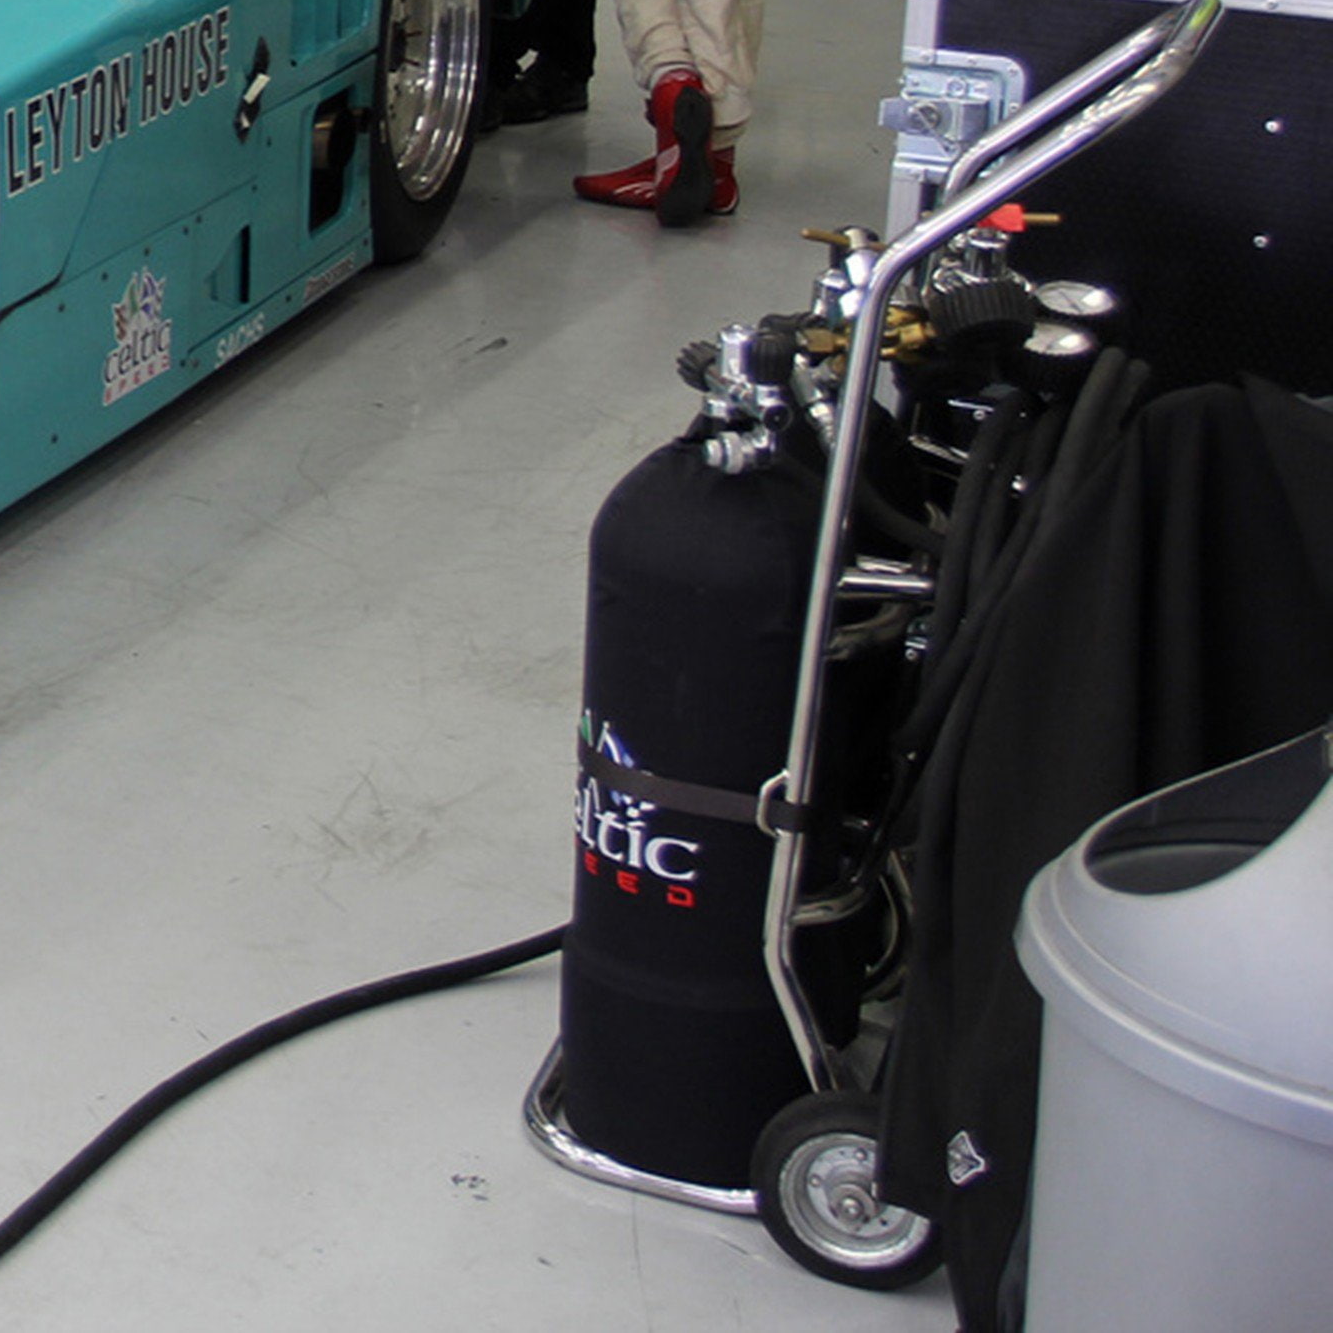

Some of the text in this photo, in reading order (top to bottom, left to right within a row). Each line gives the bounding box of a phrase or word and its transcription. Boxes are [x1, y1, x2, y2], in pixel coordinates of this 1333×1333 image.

[4, 7, 231, 198] LEYTON HOUSE
[103, 319, 171, 383] celtic
